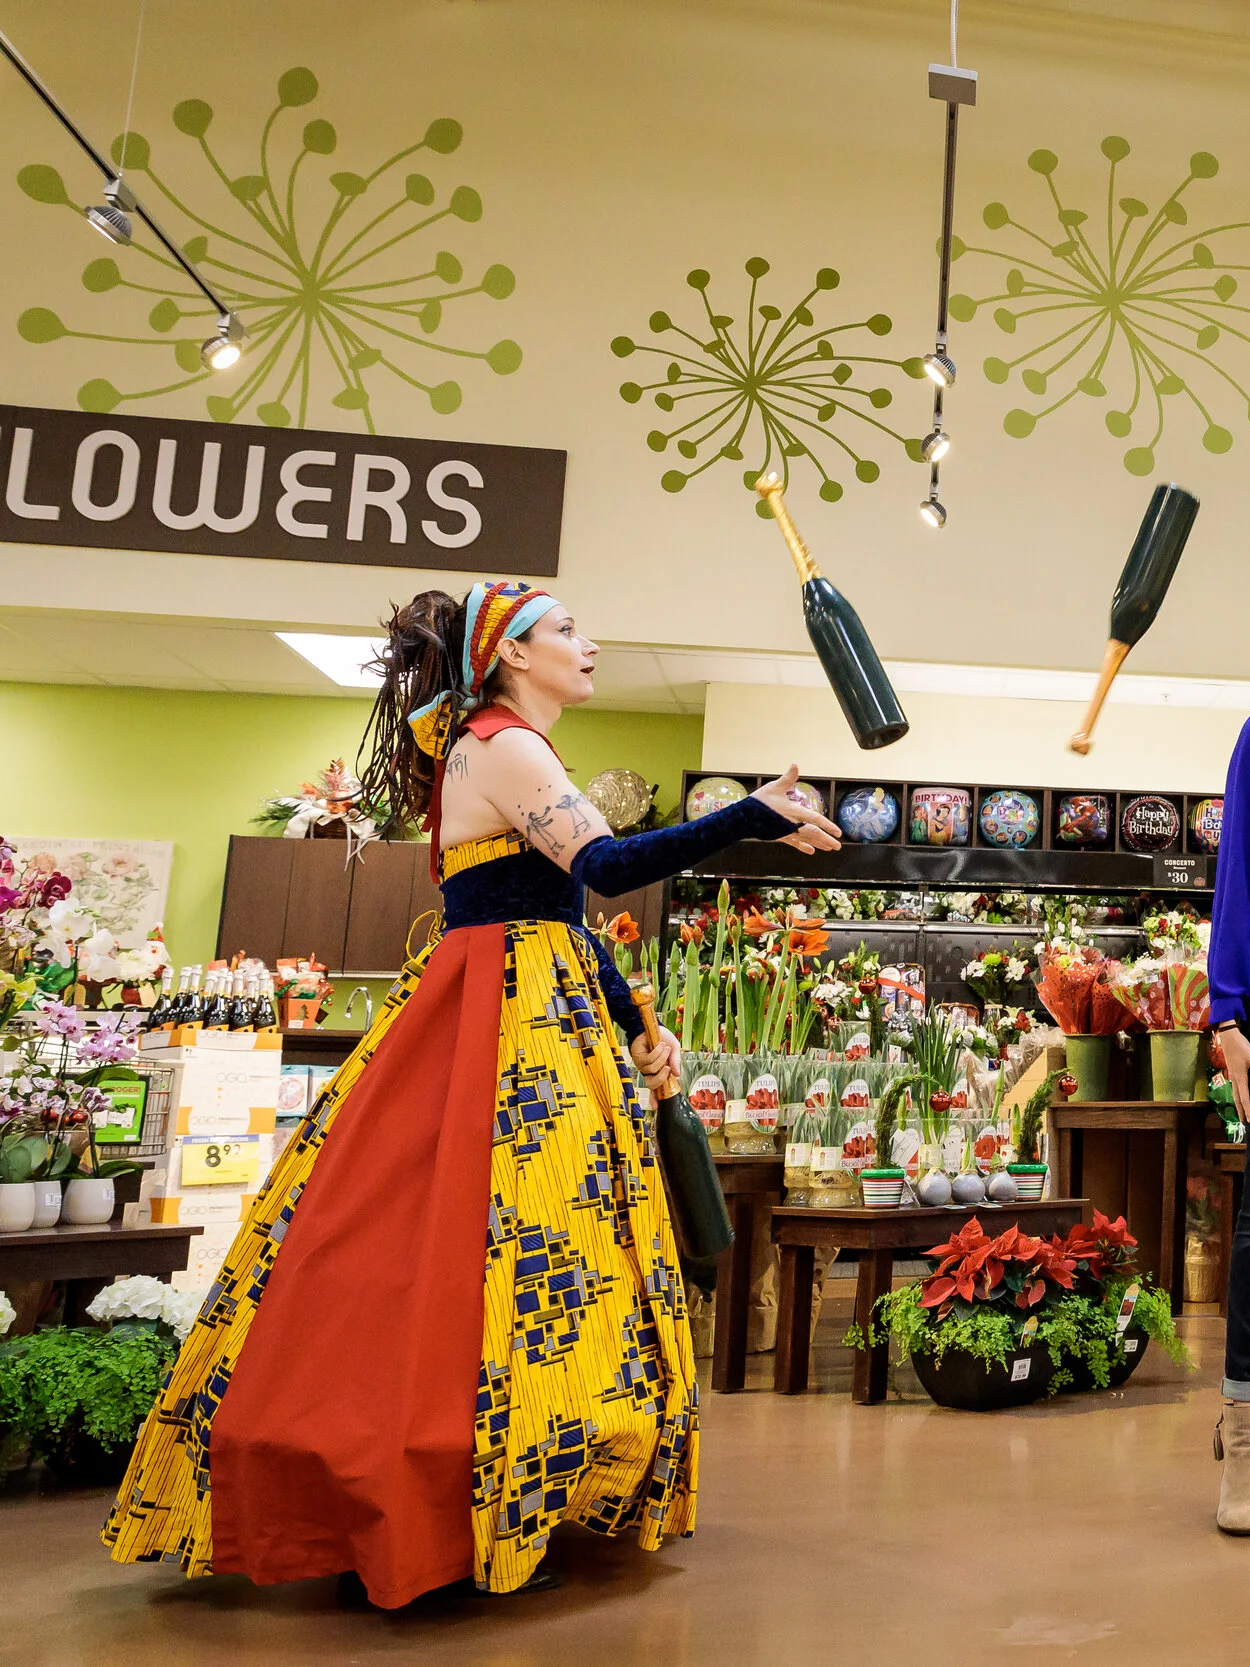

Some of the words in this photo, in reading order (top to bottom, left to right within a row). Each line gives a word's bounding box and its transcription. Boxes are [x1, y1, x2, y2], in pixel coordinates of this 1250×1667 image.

[0, 426, 484, 549] LOWERS
[1135, 806, 1170, 821] Happy
[1205, 807, 1223, 818] Hap
[1128, 822, 1175, 836] Birthday
[1167, 872, 1188, 884] $30
[697, 1080, 721, 1088] TULIPS
